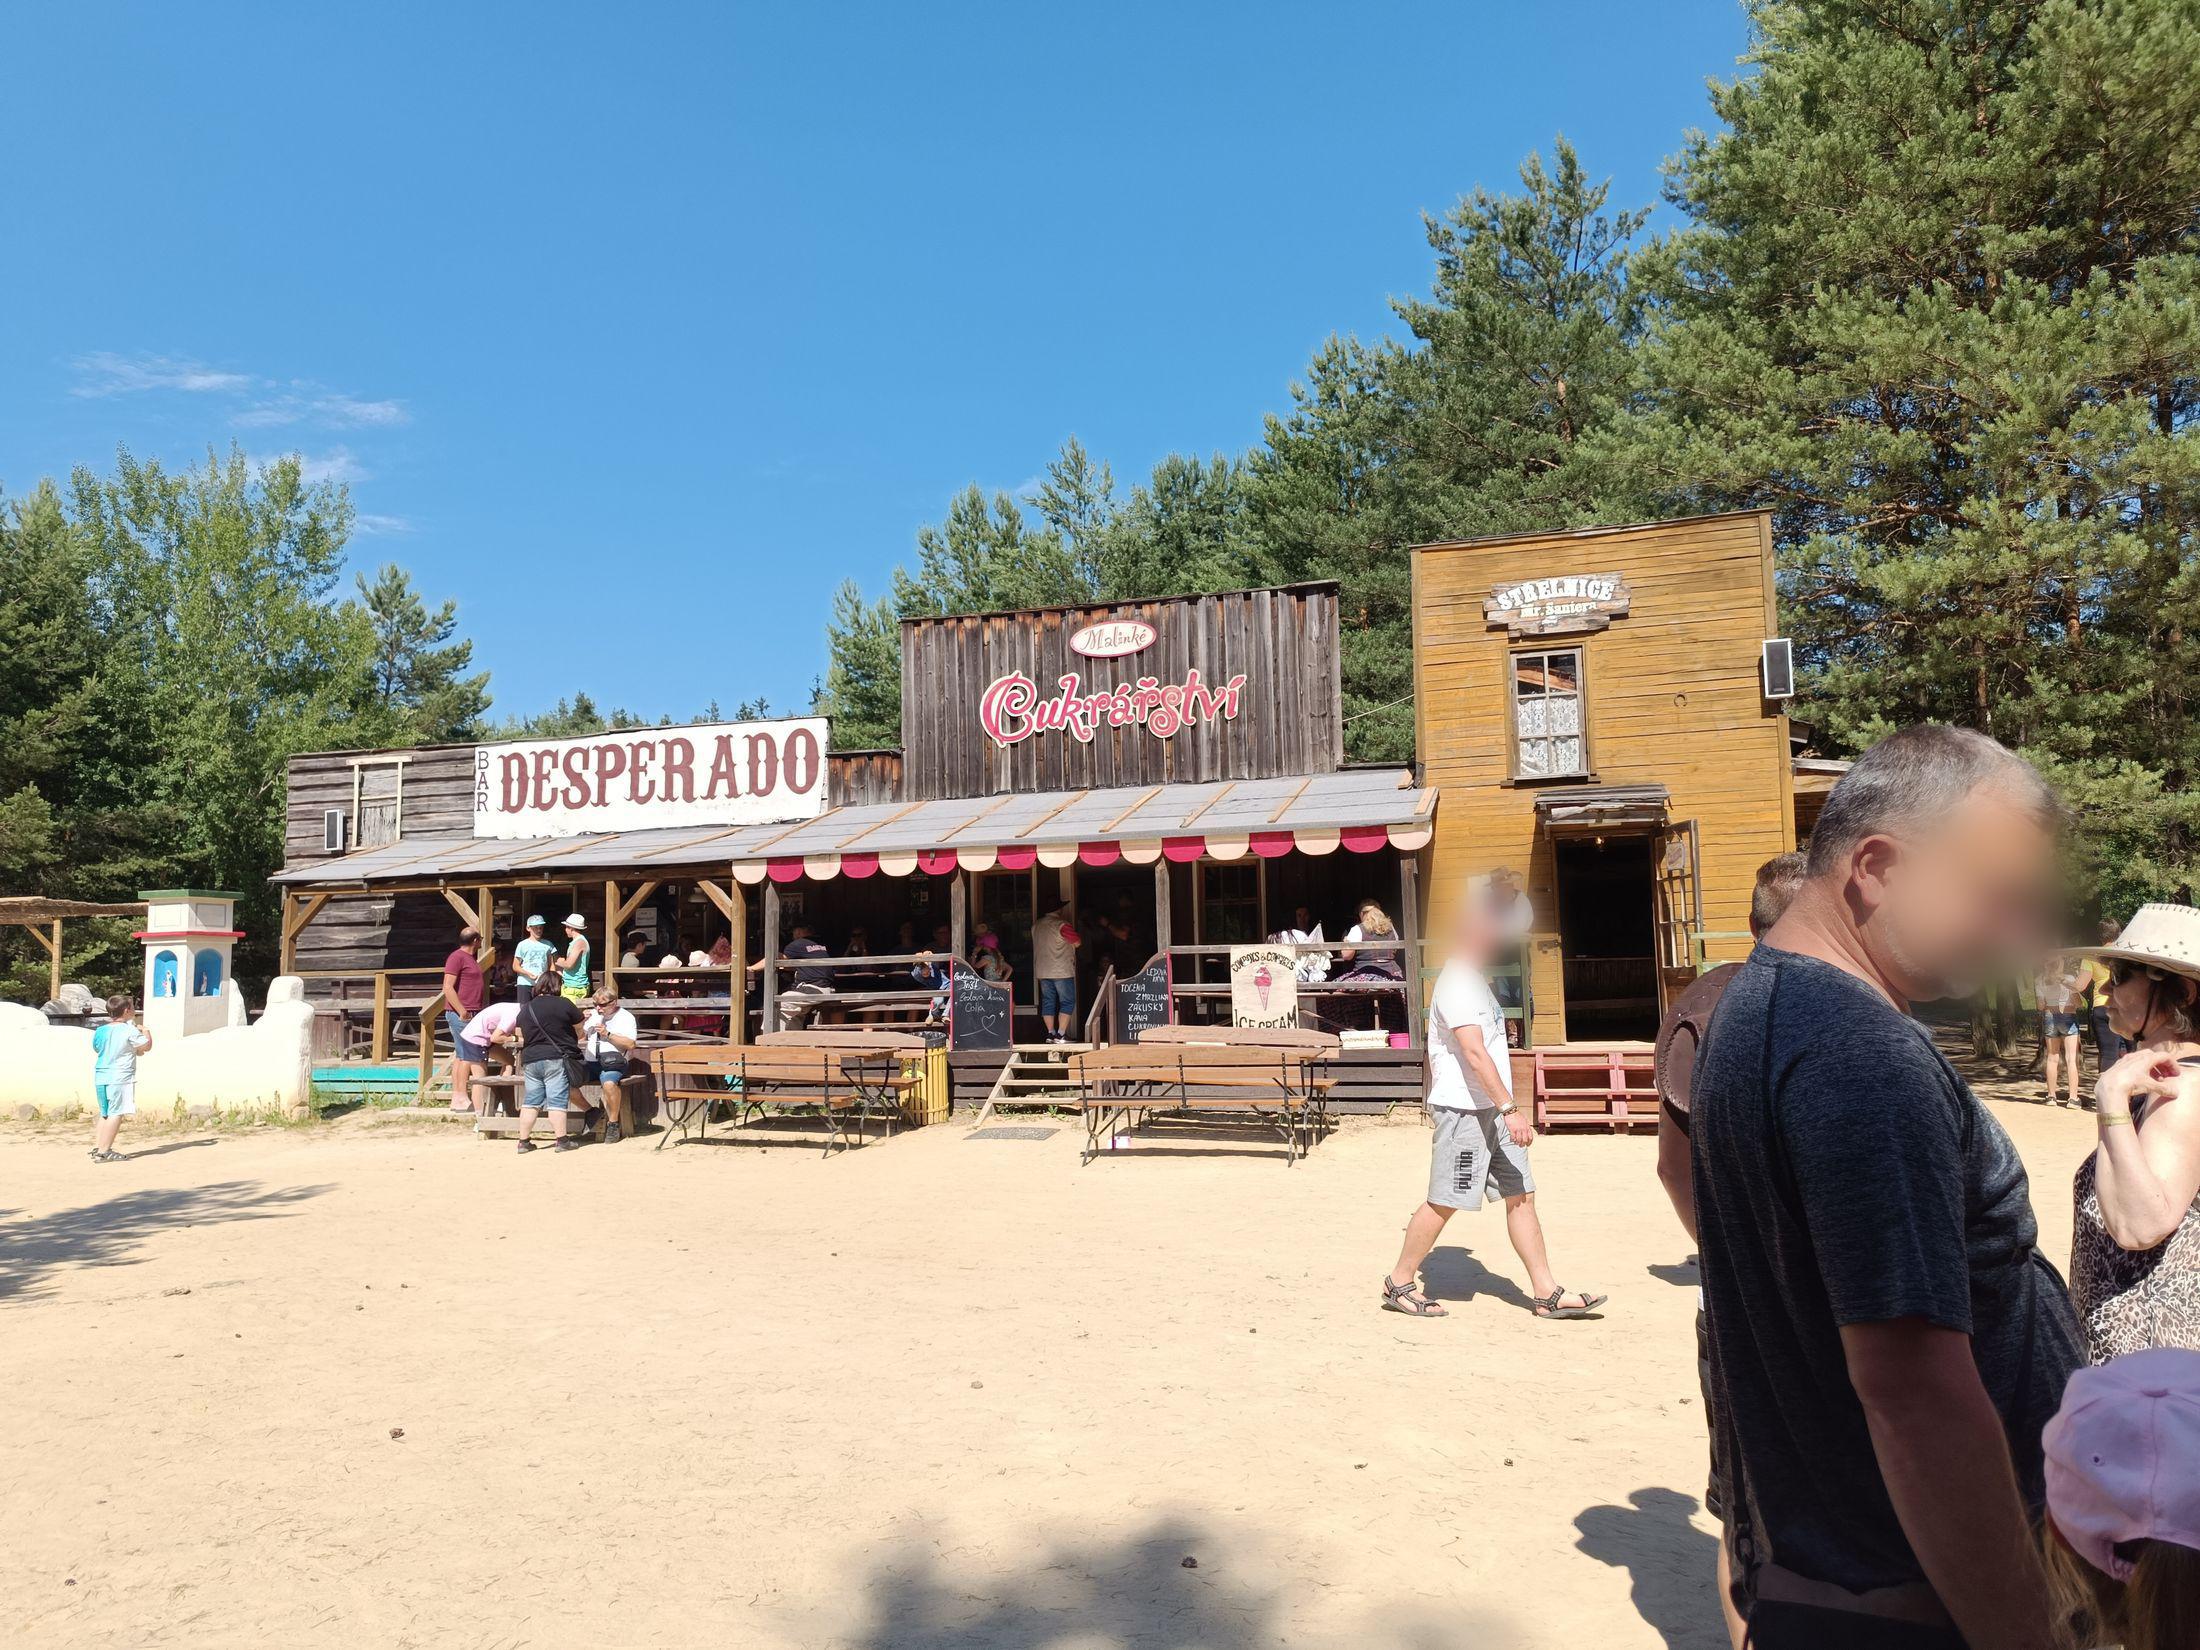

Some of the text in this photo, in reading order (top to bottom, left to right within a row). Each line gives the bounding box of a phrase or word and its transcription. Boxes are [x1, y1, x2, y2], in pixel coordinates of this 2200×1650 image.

[1080, 626, 1149, 650] Malinké
[980, 668, 1247, 748] Cukrářství
[476, 751, 489, 812] BAR
[497, 727, 820, 814] DESPERADO
[1127, 1001, 1164, 1012] ZÁKUSKY
